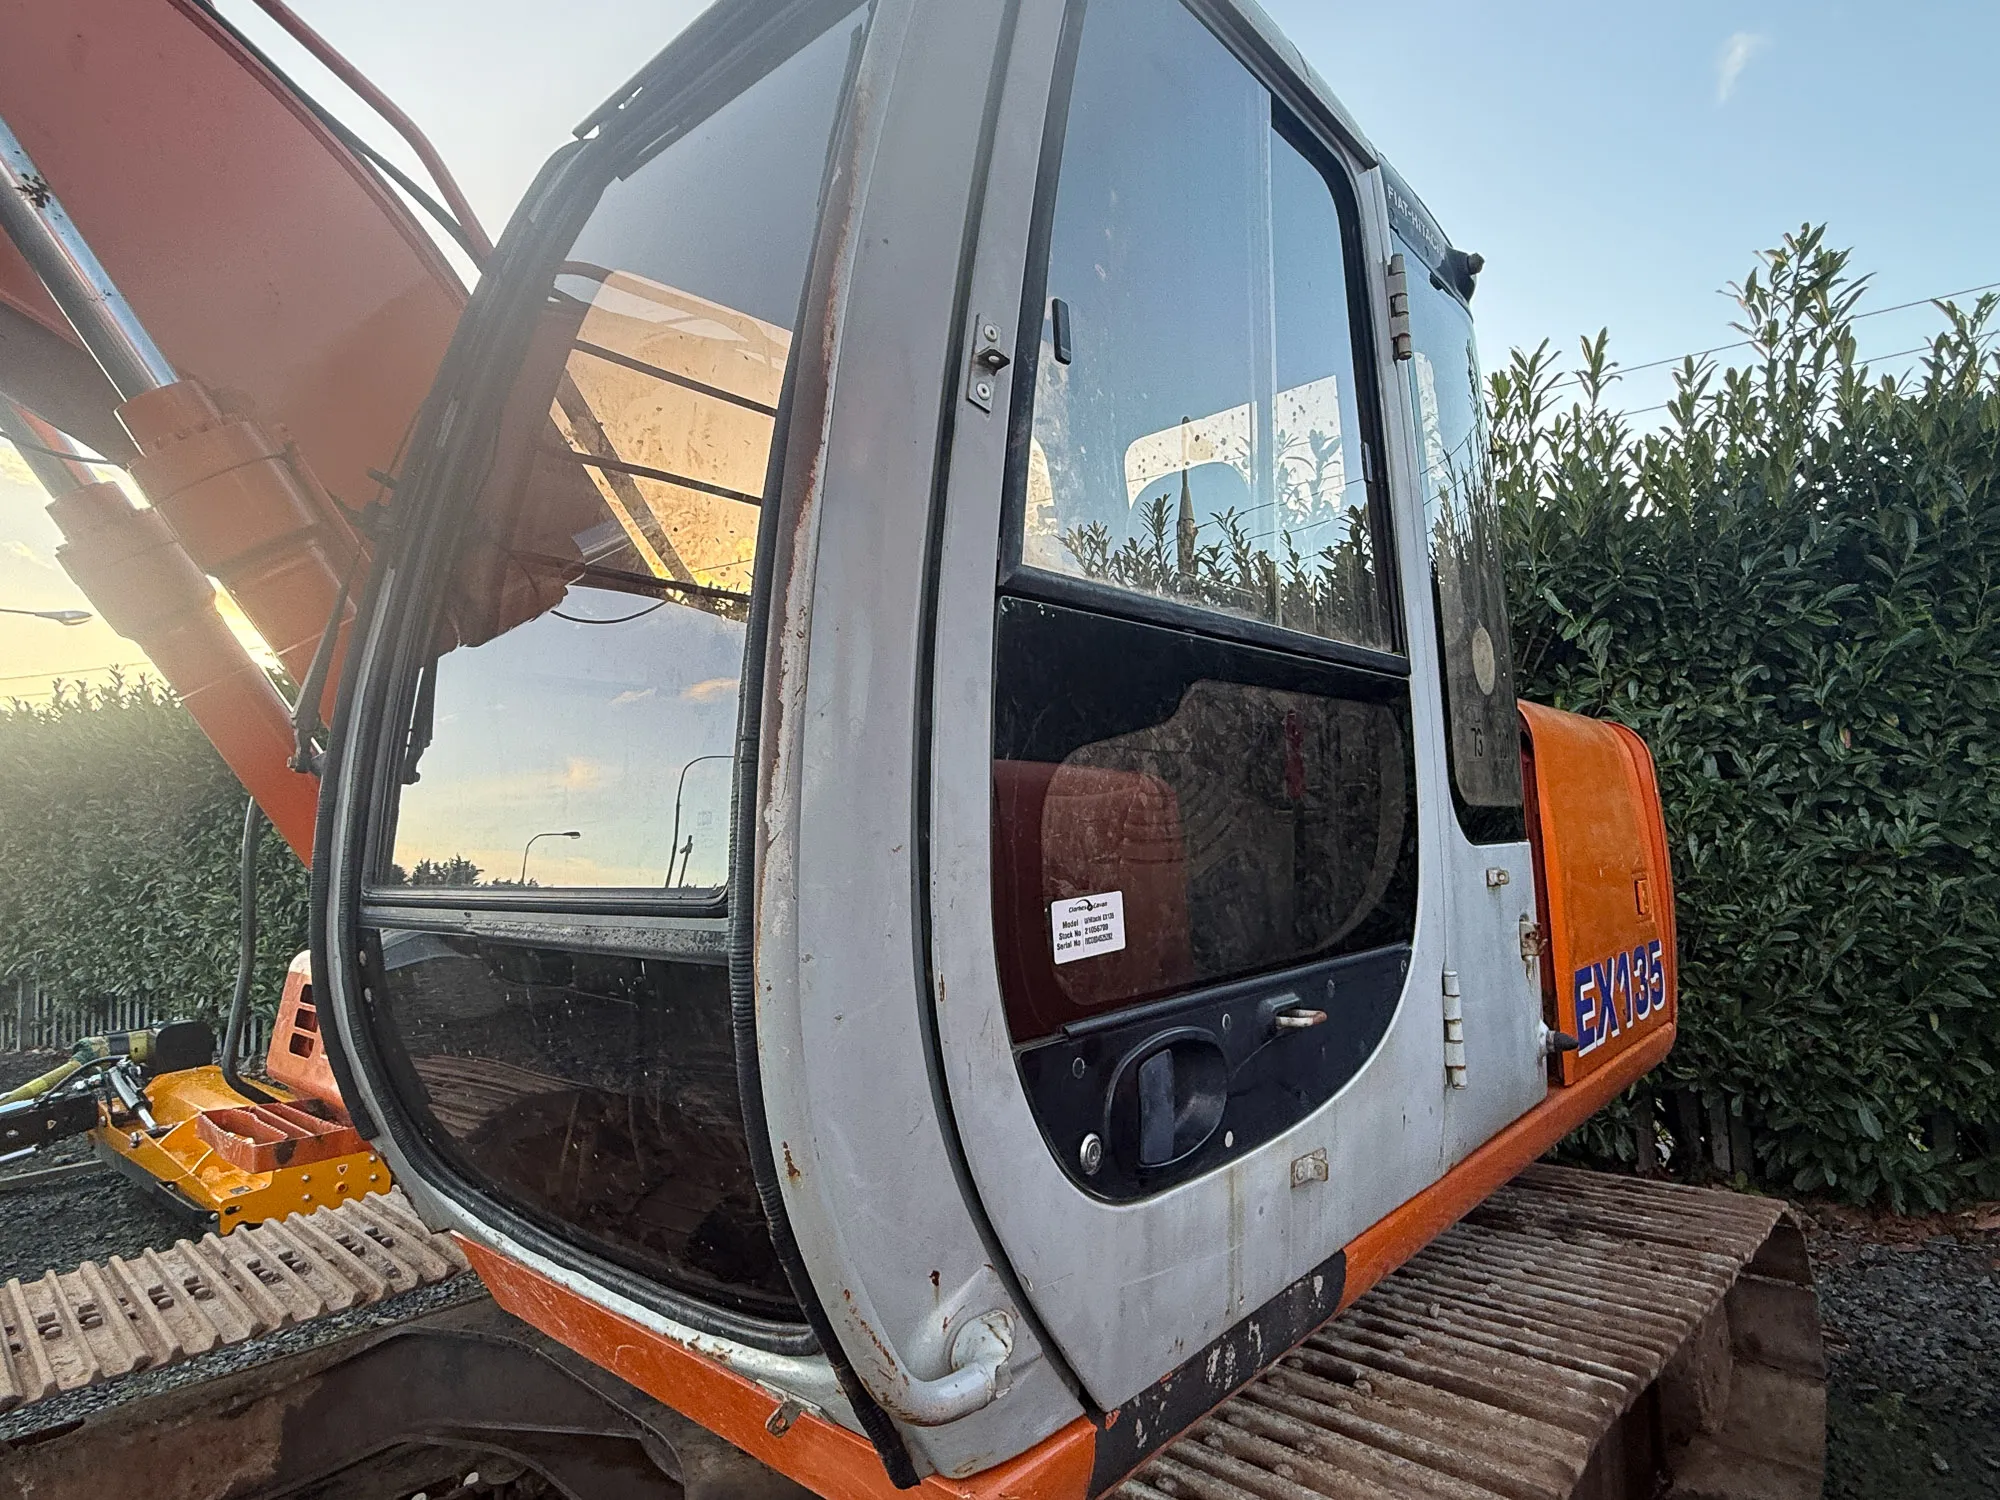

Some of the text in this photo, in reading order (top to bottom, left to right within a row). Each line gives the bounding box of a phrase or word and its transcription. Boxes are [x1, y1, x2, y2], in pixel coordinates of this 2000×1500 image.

[1062, 920, 1078, 929] Model
[1058, 932, 1073, 940] Stock
[1056, 941, 1072, 950] Serial
[1574, 938, 1665, 1058] EX135
